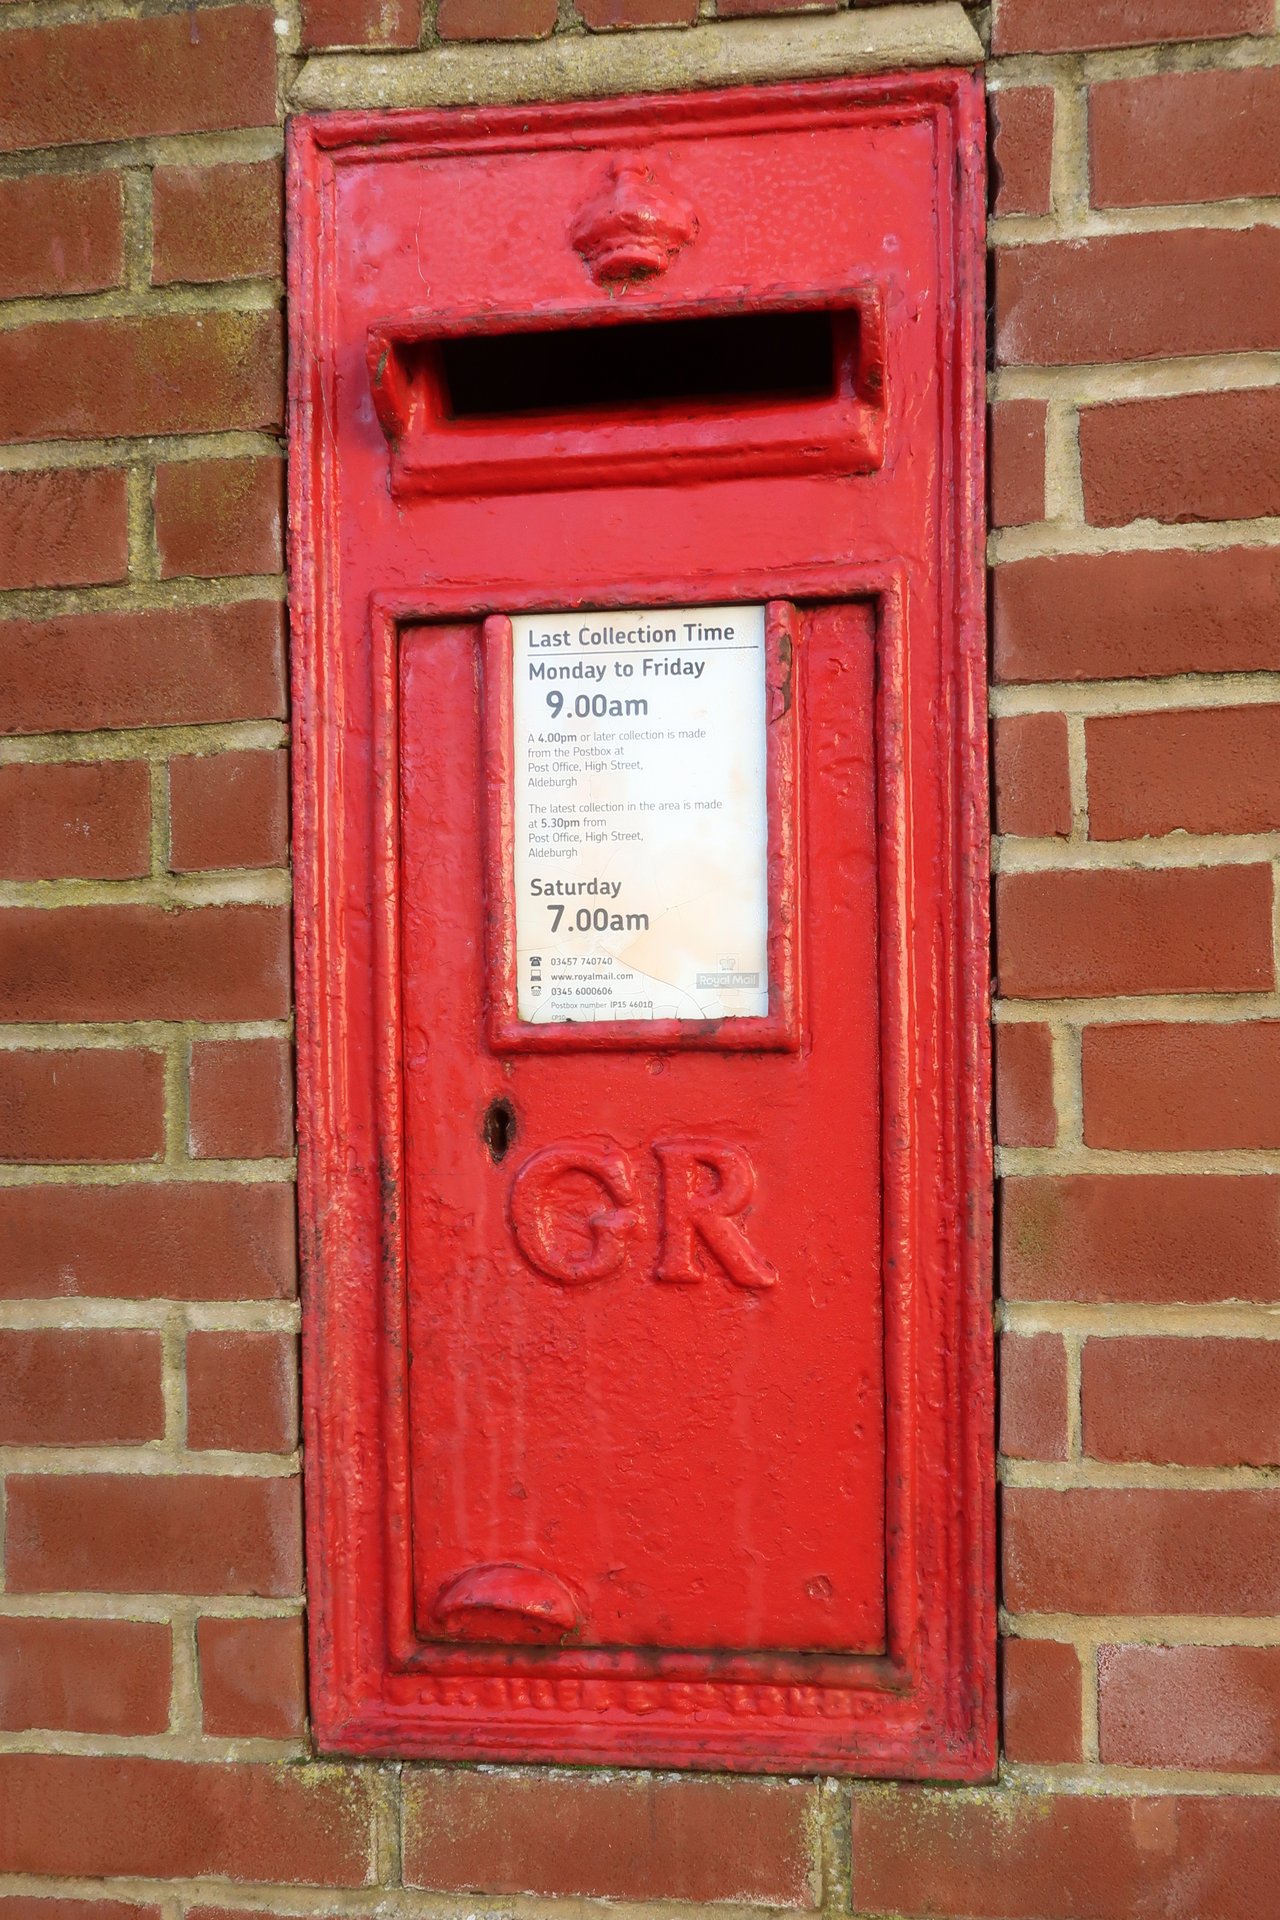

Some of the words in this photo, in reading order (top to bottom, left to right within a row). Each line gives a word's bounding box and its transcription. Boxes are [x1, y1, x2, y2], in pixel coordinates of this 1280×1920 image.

[528, 630, 571, 648] Last
[579, 625, 676, 646] Collection
[684, 623, 735, 643] Time
[528, 661, 606, 682] Monday
[614, 661, 633, 677] to
[642, 658, 705, 678] Friday
[545, 690, 648, 719] 9.00am
[528, 734, 534, 743] A
[538, 733, 577, 744] 4.00pm
[580, 733, 591, 741] or
[593, 731, 616, 741] later
[618, 730, 664, 740] collection
[667, 729, 675, 739] is
[678, 729, 706, 739] made
[528, 748, 550, 757] from
[554, 747, 570, 757] the
[573, 747, 611, 756] Postbox
[614, 746, 624, 755] at
[528, 763, 549, 773] Post
[553, 762, 582, 773] Office,
[585, 761, 607, 772] High
[611, 760, 644, 771] Street,
[528, 777, 577, 788] Aldeburgh
[528, 803, 546, 814] The
[550, 802, 575, 813] latest
[579, 802, 624, 812] collection
[628, 801, 636, 811] in
[639, 801, 655, 811] the
[658, 801, 680, 810] area
[684, 800, 691, 810] is
[694, 800, 722, 809] made
[528, 819, 537, 828] at
[541, 818, 580, 829] 5.30pm
[583, 817, 606, 827] from
[528, 833, 549, 843] Post
[553, 832, 582, 843] Office,
[585, 832, 608, 842] High
[611, 831, 644, 842] Street,
[528, 848, 578, 859] Aldeburgh
[530, 877, 622, 898] Saturday
[547, 904, 649, 933] 7.00am
[550, 957, 577, 966] 03457
[581, 957, 613, 965] 740740
[550, 972, 634, 981] www.royalmail.com
[700, 975, 729, 987] Royal
[732, 974, 756, 985] Mail
[551, 988, 574, 996] 0345
[576, 988, 613, 996] 6000606
[551, 1001, 578, 1009] Postbox
[580, 1001, 606, 1009] number
[610, 1000, 626, 1008] IP15
[507, 1138, 778, 1288] GR
